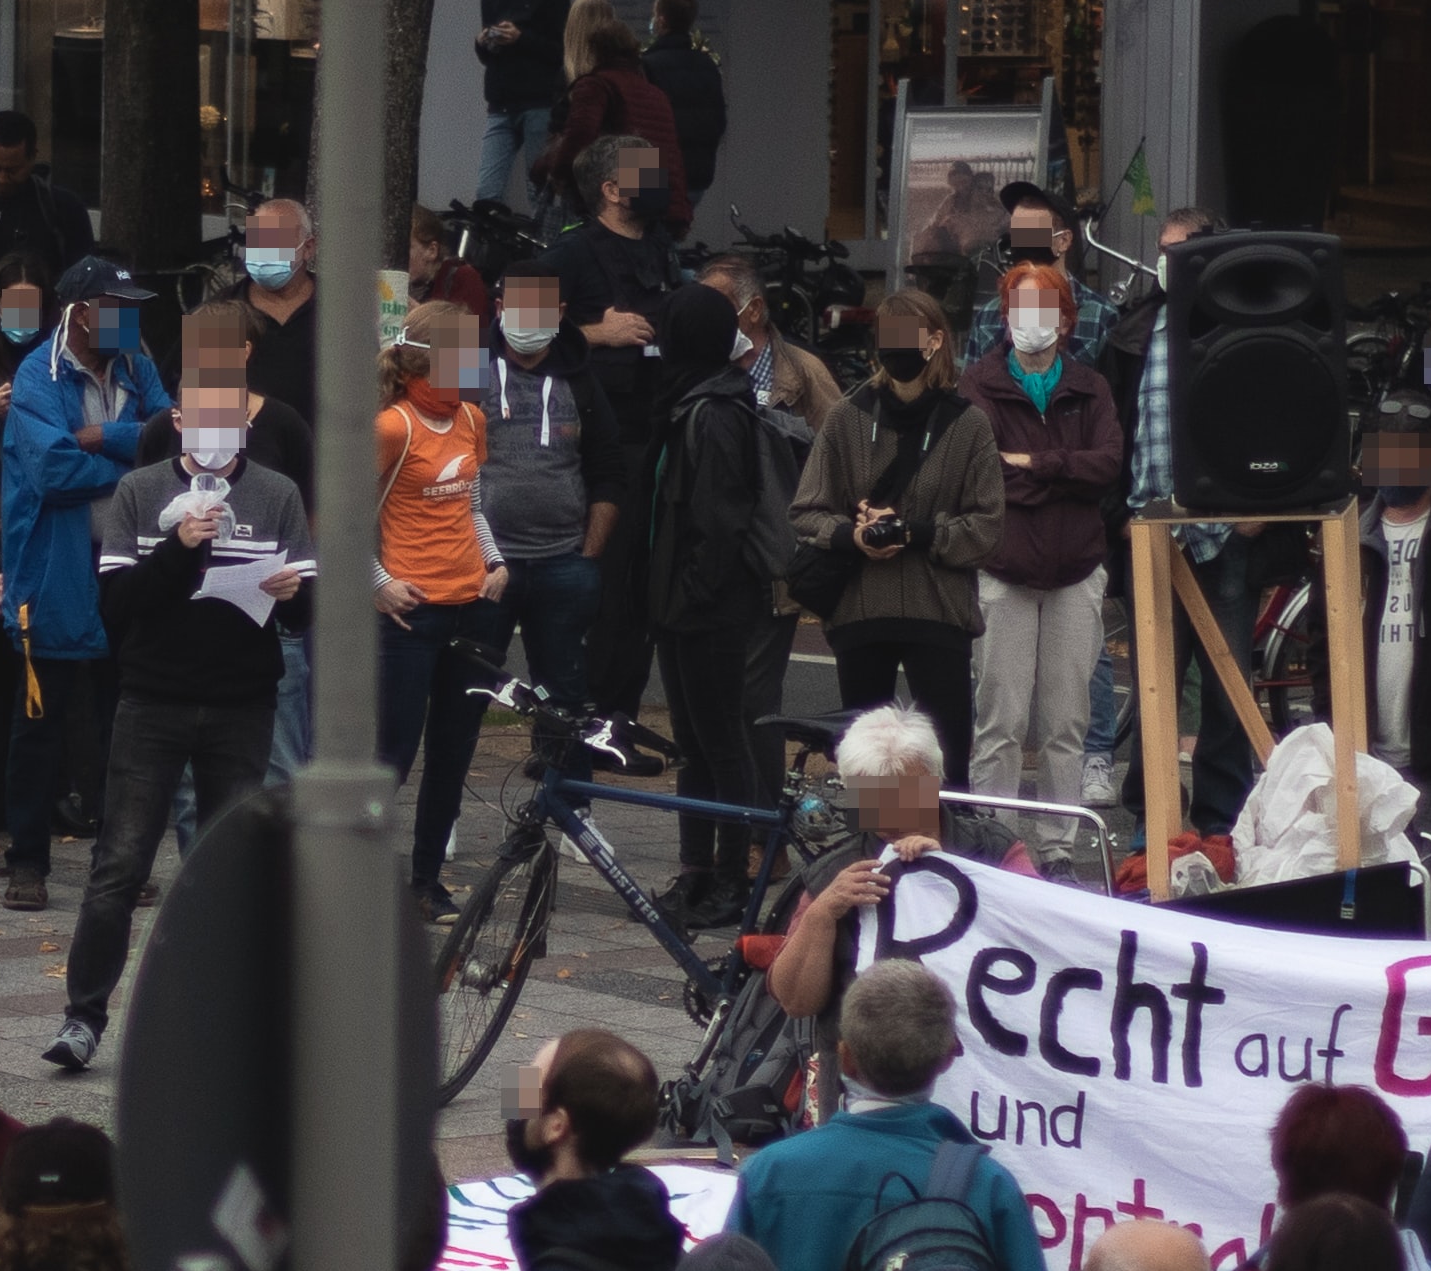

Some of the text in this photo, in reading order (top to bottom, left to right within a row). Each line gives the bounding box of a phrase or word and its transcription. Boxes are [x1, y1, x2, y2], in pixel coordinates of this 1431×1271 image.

[875, 846, 1225, 1088] Recht
[1233, 1004, 1356, 1085] auf
[970, 1091, 1085, 1149] und
